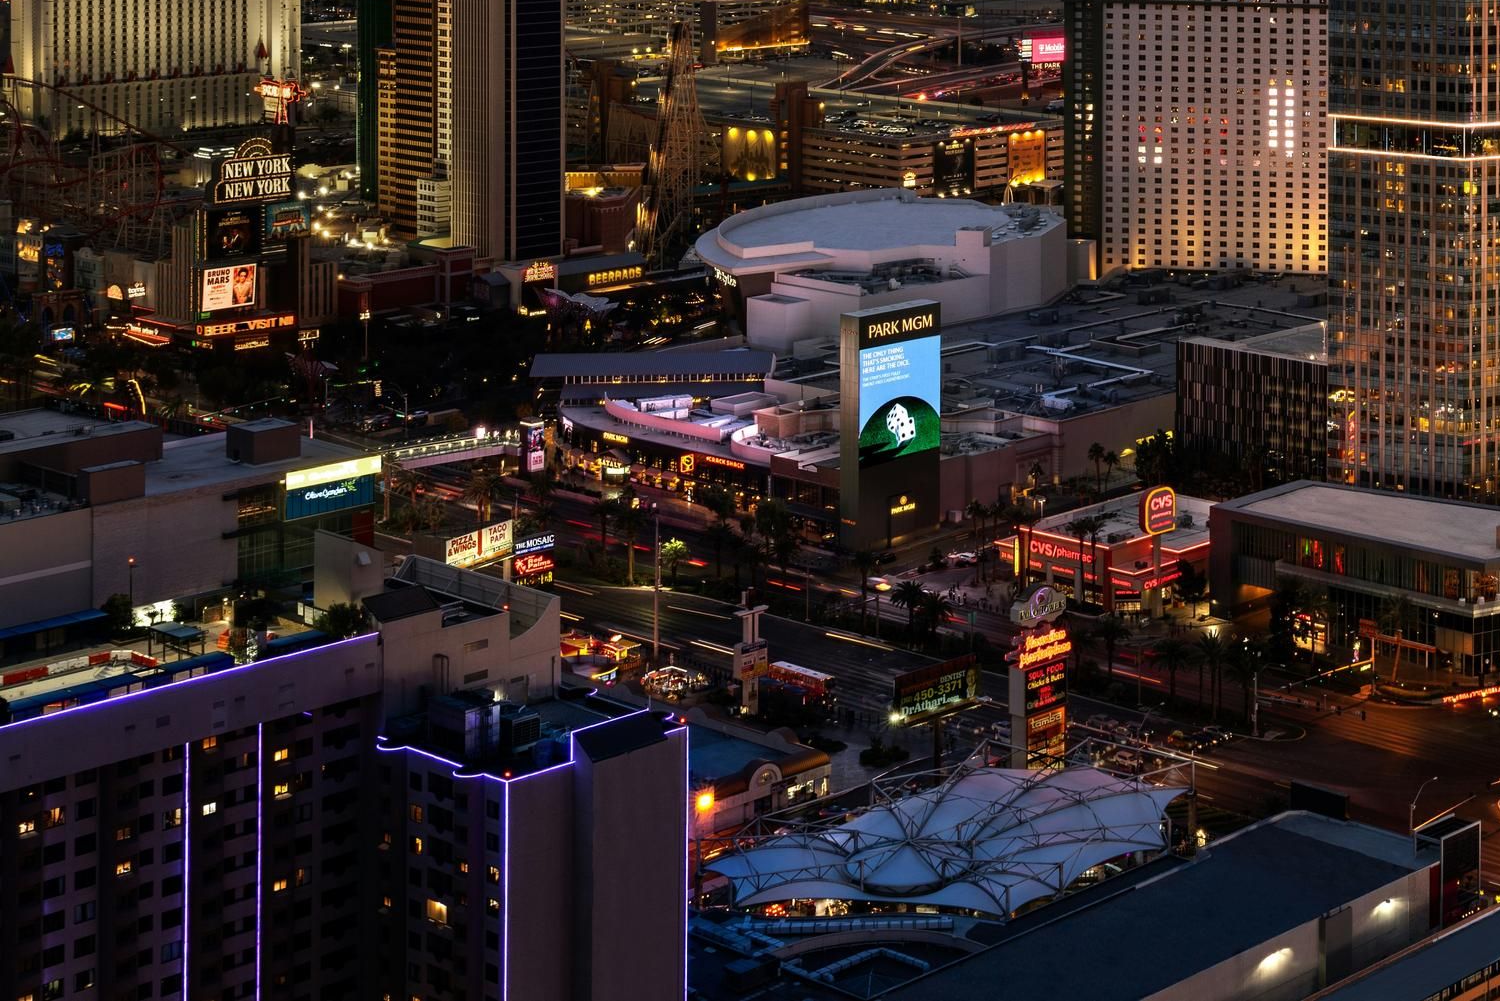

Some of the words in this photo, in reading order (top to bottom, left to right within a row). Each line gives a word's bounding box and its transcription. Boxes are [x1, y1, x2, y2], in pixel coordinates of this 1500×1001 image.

[225, 161, 254, 179] NEW
[256, 157, 291, 175] YORK
[225, 181, 254, 199] NEW
[257, 177, 290, 195] YORK
[207, 268, 230, 278] BRUNO
[207, 275, 230, 285] MARS
[203, 323, 236, 336] BEER
[247, 317, 278, 331] VISIT
[868, 319, 899, 339] PARK
[902, 314, 933, 332] MGM
[726, 460, 745, 469] SHACK
[1151, 494, 1173, 511] CVS
[488, 523, 507, 536] TACO
[451, 534, 473, 548] PIZZA
[490, 533, 506, 544] PAPI
[515, 542, 526, 550] THE
[526, 534, 555, 549] MOSAIC
[447, 547, 453, 557] &
[453, 540, 477, 554] WINGS
[1029, 540, 1097, 564] CVS/pharmac
[940, 670, 967, 684] DENTIST
[1028, 669, 1045, 681] SOUL
[1046, 662, 1064, 675] FOOD
[913, 679, 962, 702] 450-3371
[1030, 711, 1062, 729] tamba
